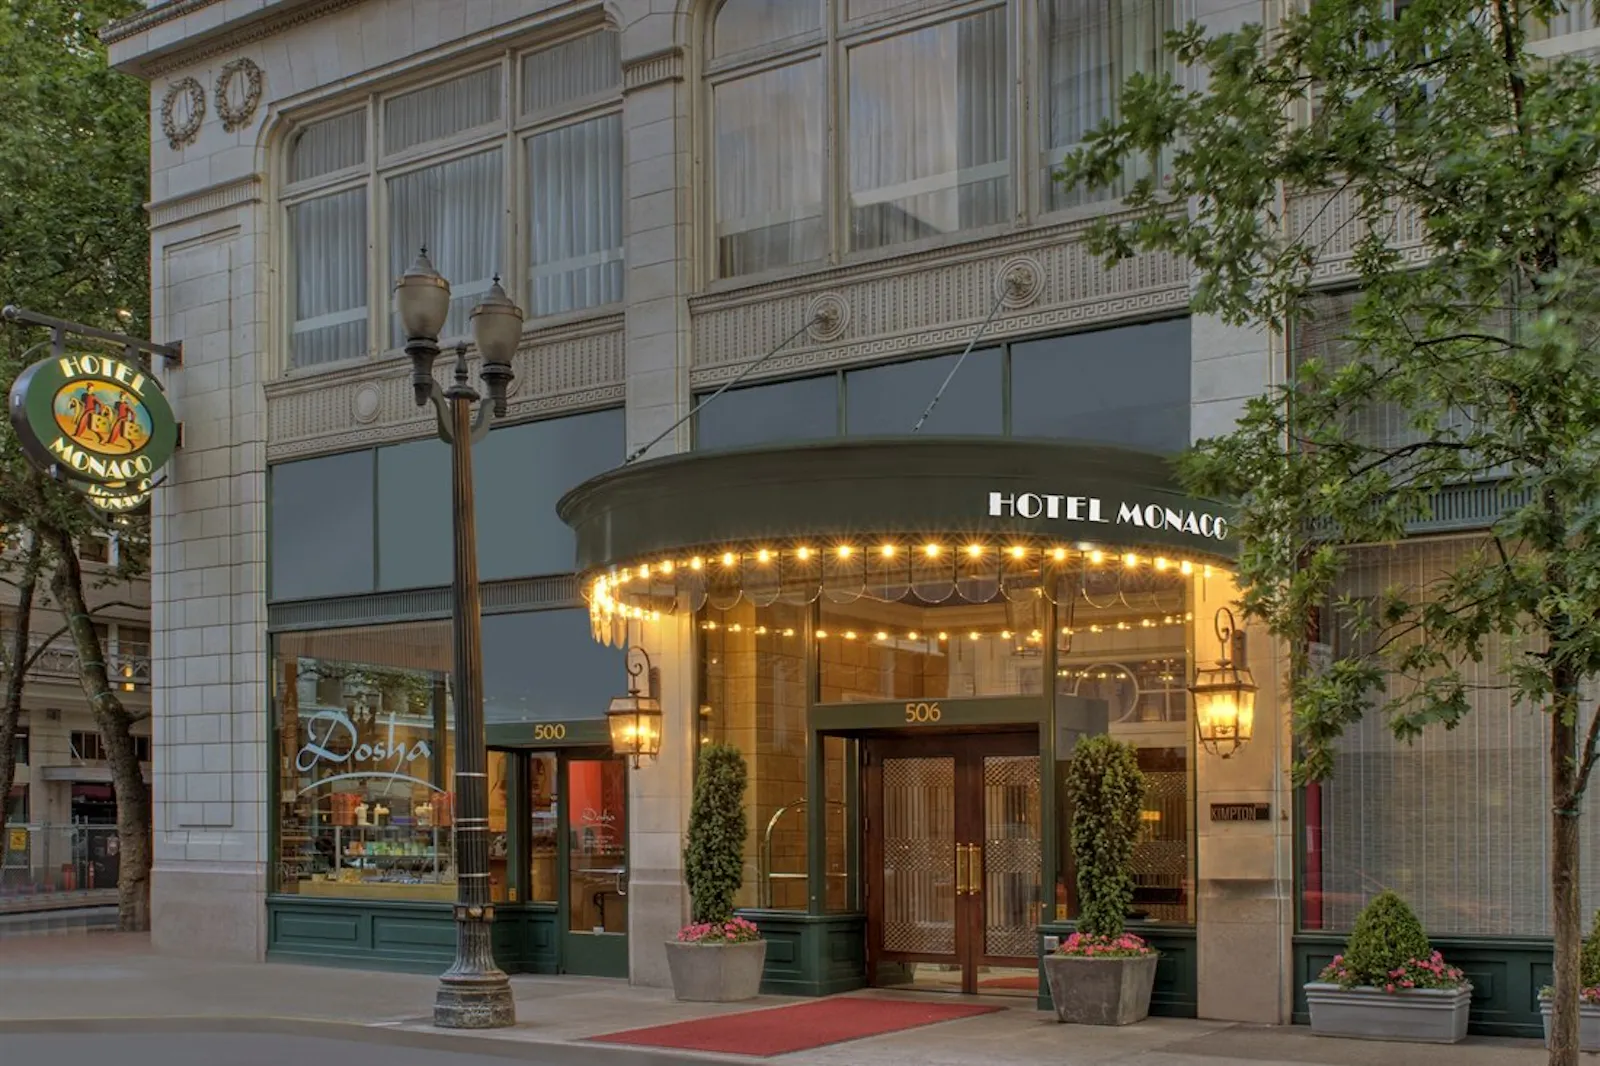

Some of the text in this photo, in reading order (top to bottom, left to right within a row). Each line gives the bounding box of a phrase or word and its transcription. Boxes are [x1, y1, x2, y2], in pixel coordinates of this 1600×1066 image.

[59, 354, 145, 397] HOTEL
[49, 436, 152, 479] MONACO
[989, 491, 1229, 541] HOTEL MONACO
[534, 724, 566, 740] 500
[905, 702, 941, 723] 506
[295, 711, 432, 795] Dosha
[1211, 806, 1257, 821] KIMPTON
